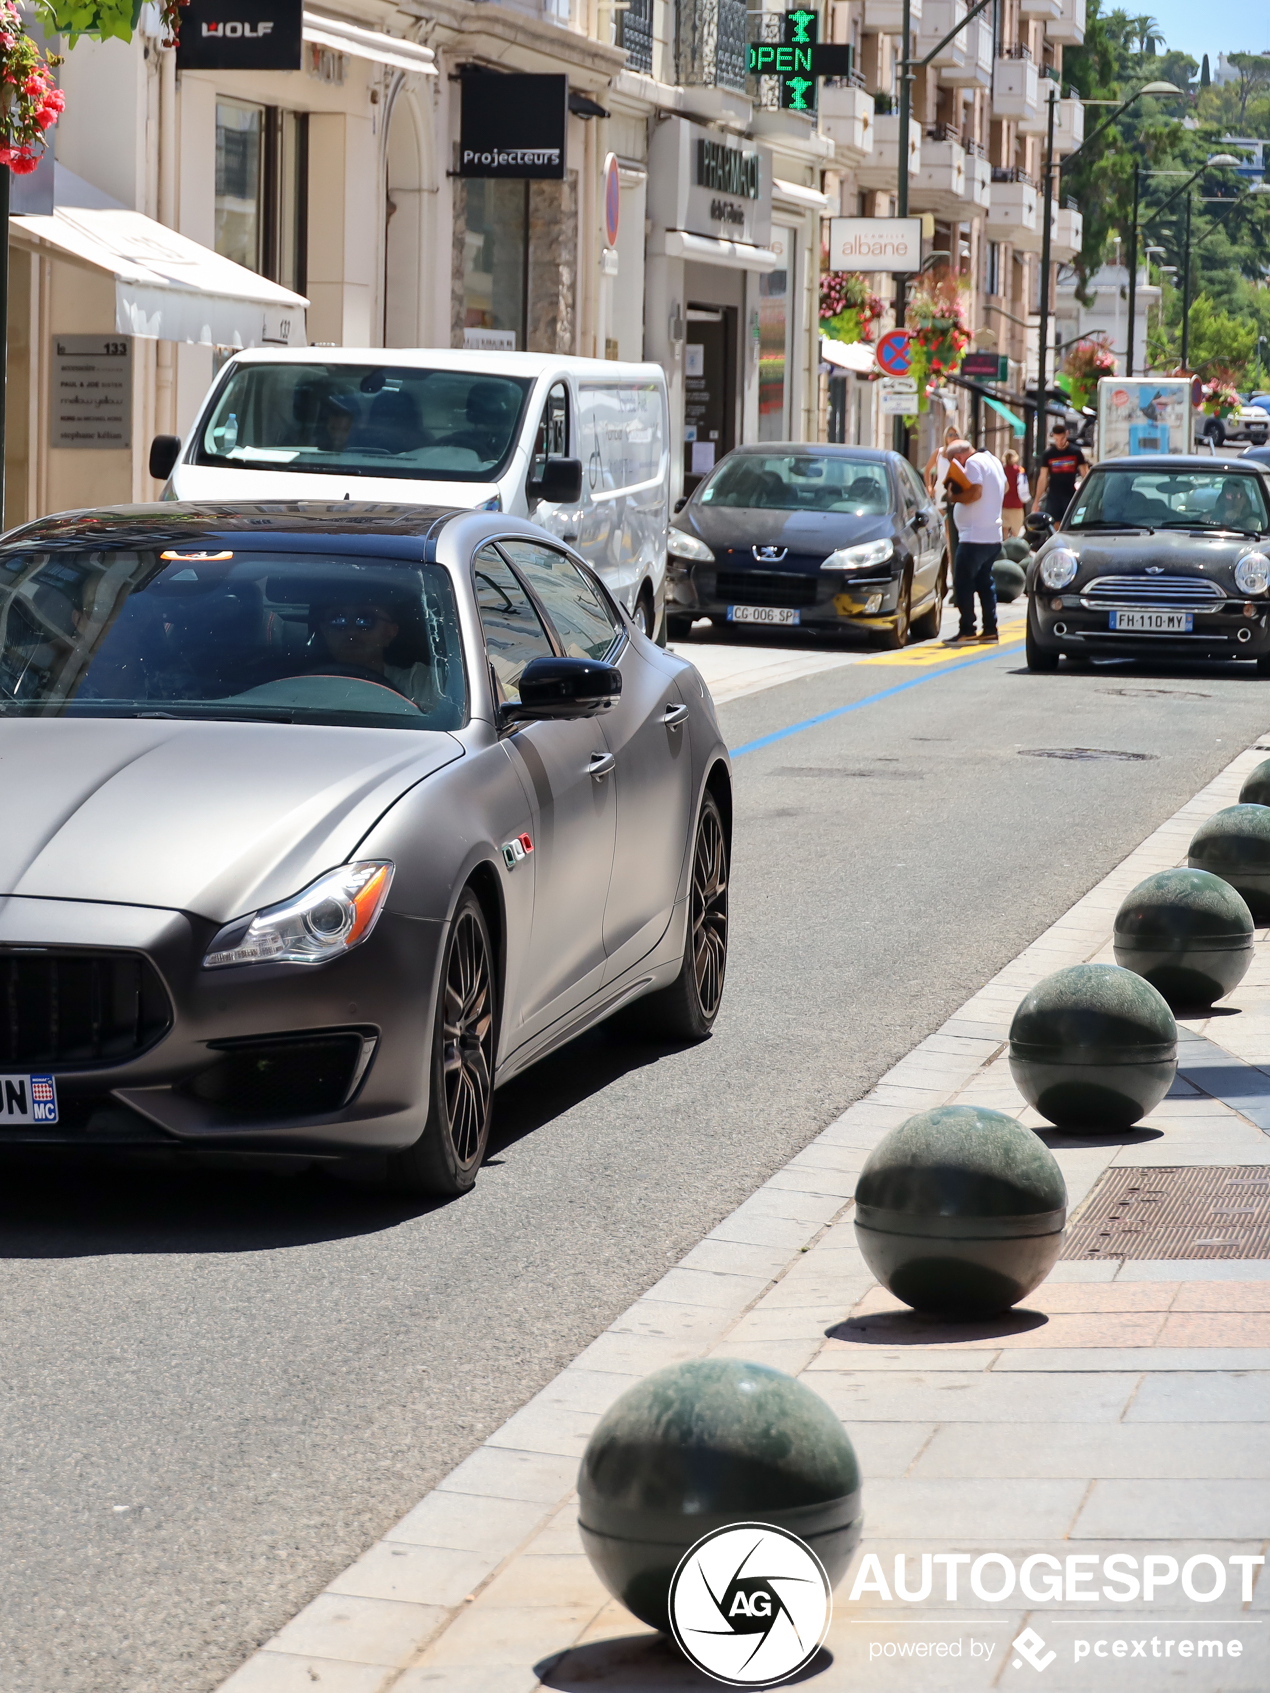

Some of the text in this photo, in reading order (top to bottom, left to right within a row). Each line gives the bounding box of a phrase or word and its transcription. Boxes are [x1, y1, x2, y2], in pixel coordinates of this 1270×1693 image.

[201, 21, 274, 38] WOLF
[464, 148, 560, 168] Projecteurs
[842, 234, 908, 257] albane
[104, 342, 127, 354] 133
[734, 607, 793, 622] CG-006-SP
[1119, 614, 1183, 628] FH-110-MY
[33, 1103, 55, 1119] MC
